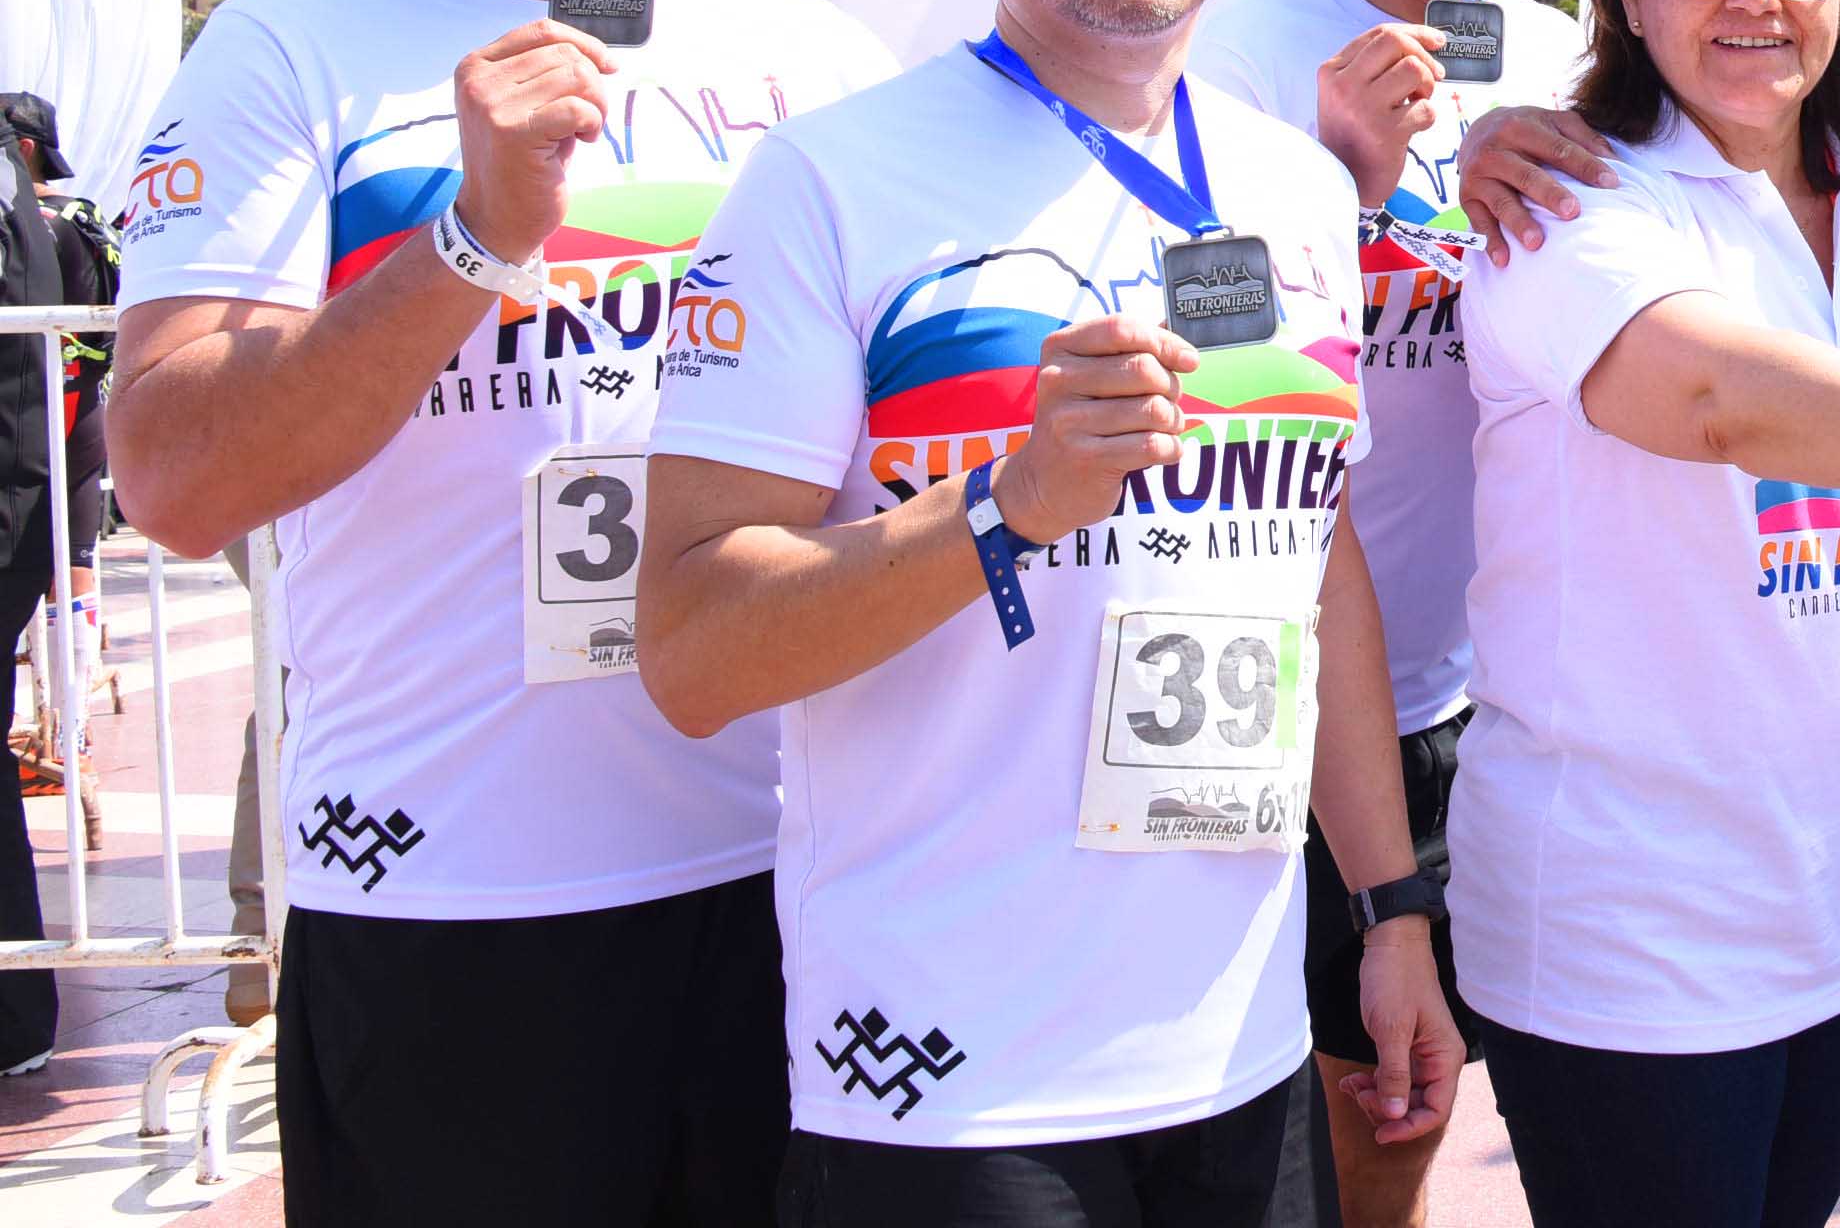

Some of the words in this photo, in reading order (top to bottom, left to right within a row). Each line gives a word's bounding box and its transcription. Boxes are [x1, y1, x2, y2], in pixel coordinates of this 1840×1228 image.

[1449, 43, 1497, 55] FRONTERAS
[156, 206, 202, 221] Turismo
[141, 224, 165, 238] Arica
[1176, 300, 1196, 314] SIN
[1200, 291, 1266, 311] FRONTERAS
[694, 349, 740, 369] Turismo
[676, 362, 702, 378] Arica
[556, 474, 639, 583] 3
[1758, 535, 1822, 598] SIN
[589, 647, 614, 663] SIN
[1125, 633, 1279, 749] 39
[1144, 819, 1168, 834] SIN
[1171, 818, 1249, 835] FRONTERAS
